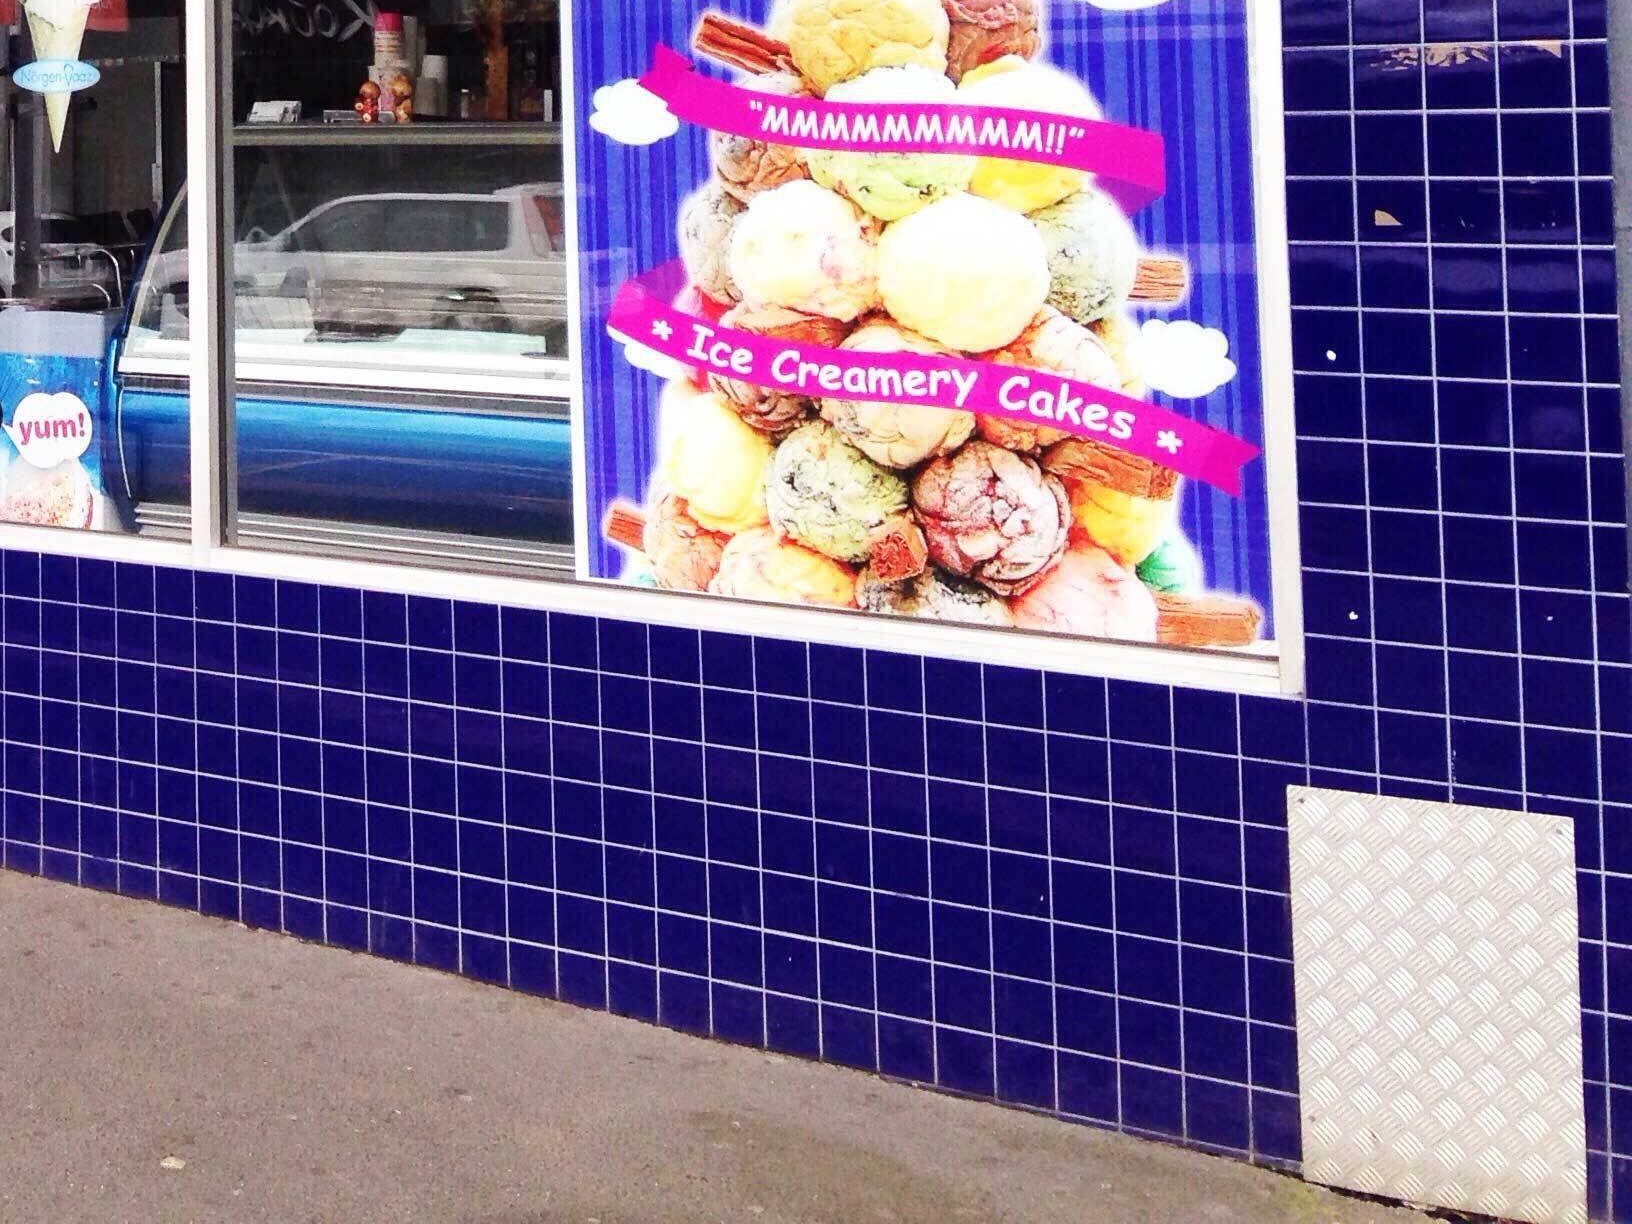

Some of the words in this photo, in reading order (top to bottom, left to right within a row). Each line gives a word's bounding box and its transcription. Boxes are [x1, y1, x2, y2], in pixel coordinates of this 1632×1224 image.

[685, 323, 754, 374] Ice
[770, 349, 980, 408] Creamery
[997, 375, 1137, 441] Cakes
[18, 412, 86, 446] yum!
